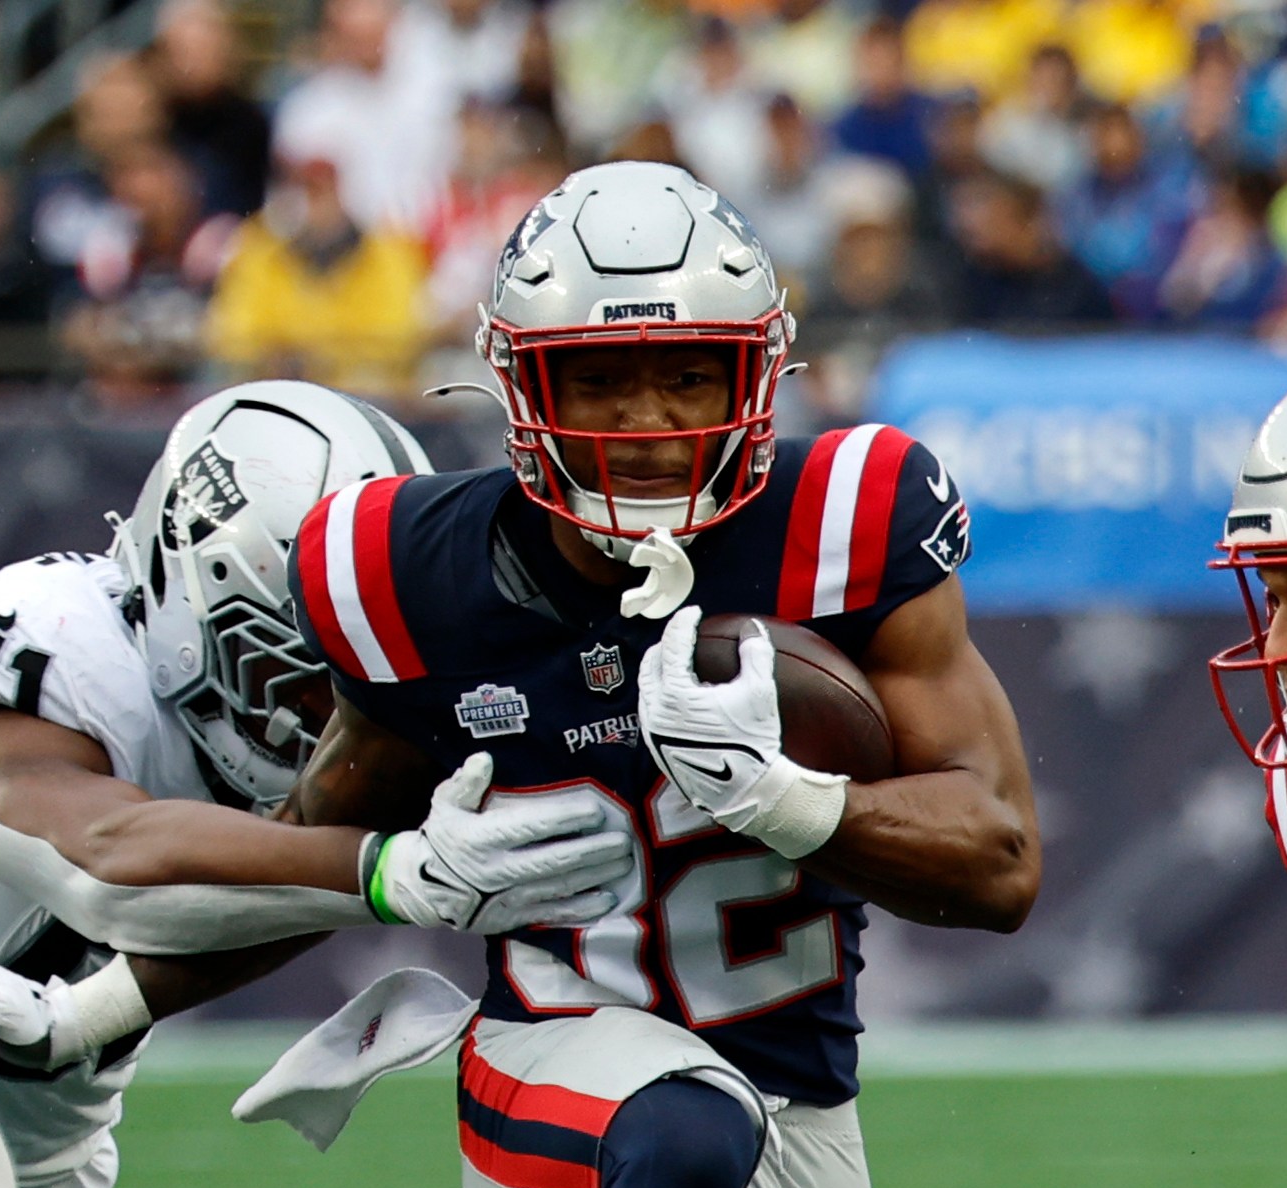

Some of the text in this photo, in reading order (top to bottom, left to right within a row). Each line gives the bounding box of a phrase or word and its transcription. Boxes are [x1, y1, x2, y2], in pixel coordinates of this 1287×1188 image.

[603, 302, 677, 325] PATRIOTS
[199, 446, 242, 505] RAIDERS
[589, 665, 619, 687] NFL
